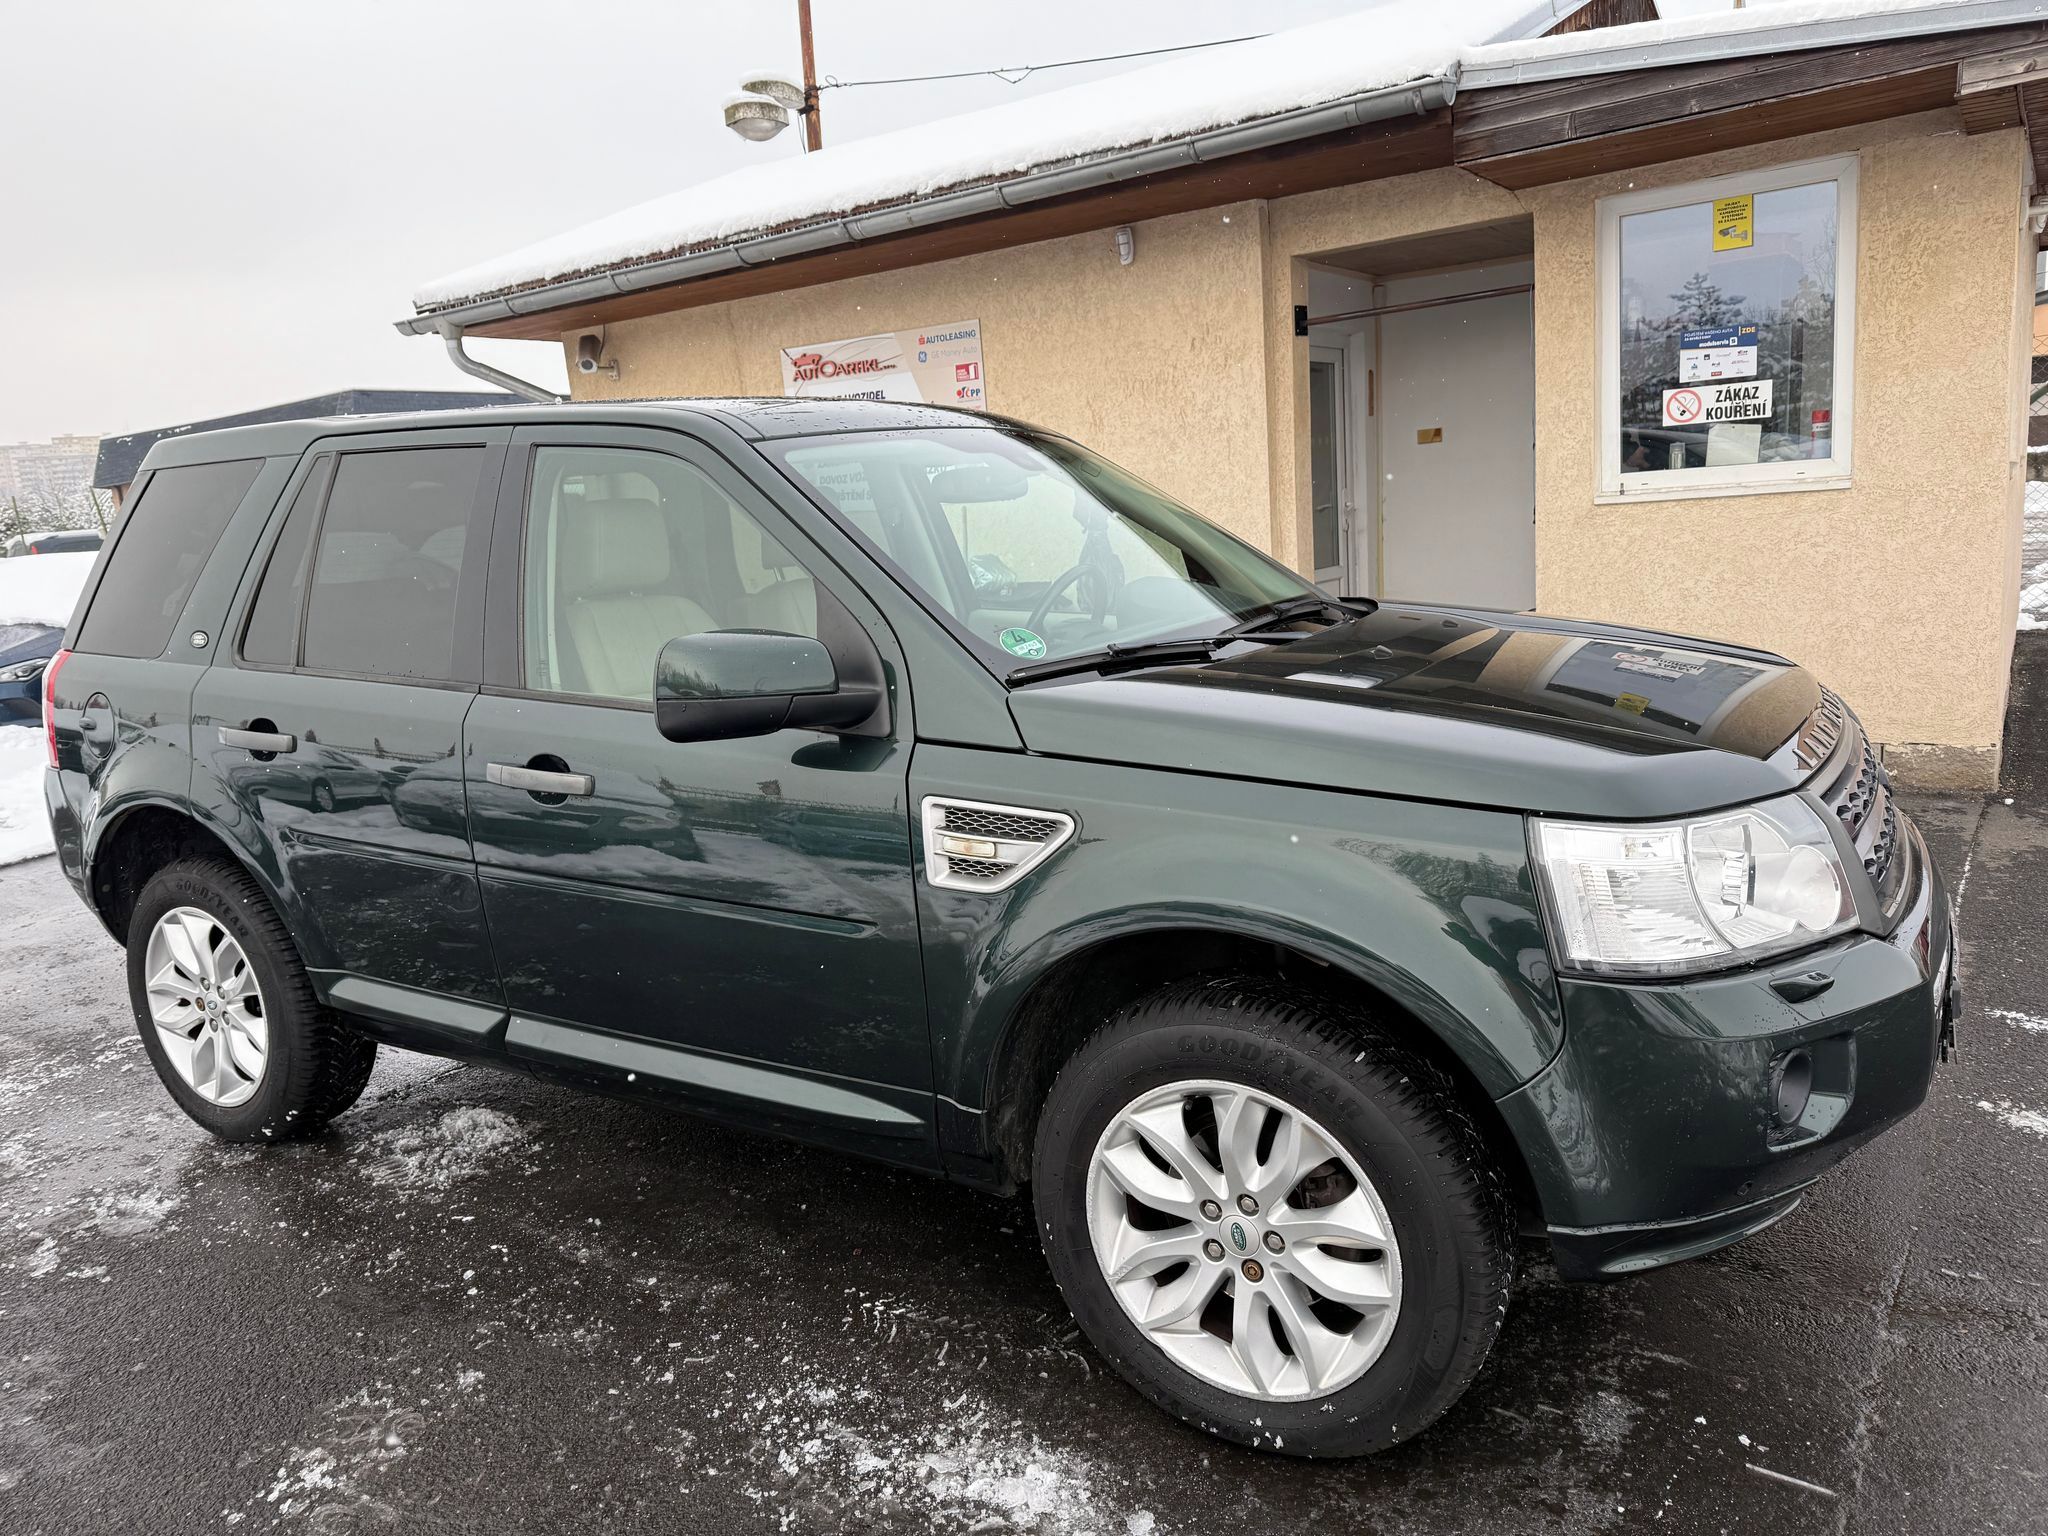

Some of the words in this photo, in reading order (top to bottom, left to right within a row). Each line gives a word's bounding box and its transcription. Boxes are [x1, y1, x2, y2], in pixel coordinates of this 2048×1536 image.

[926, 330, 977, 344] AUTOLEASING
[1741, 326, 1756, 335] ZDE
[1716, 386, 1759, 403] ZÁKAZ
[1706, 399, 1767, 420] KOUŘENÍ
[819, 474, 848, 485] DOVOZ
